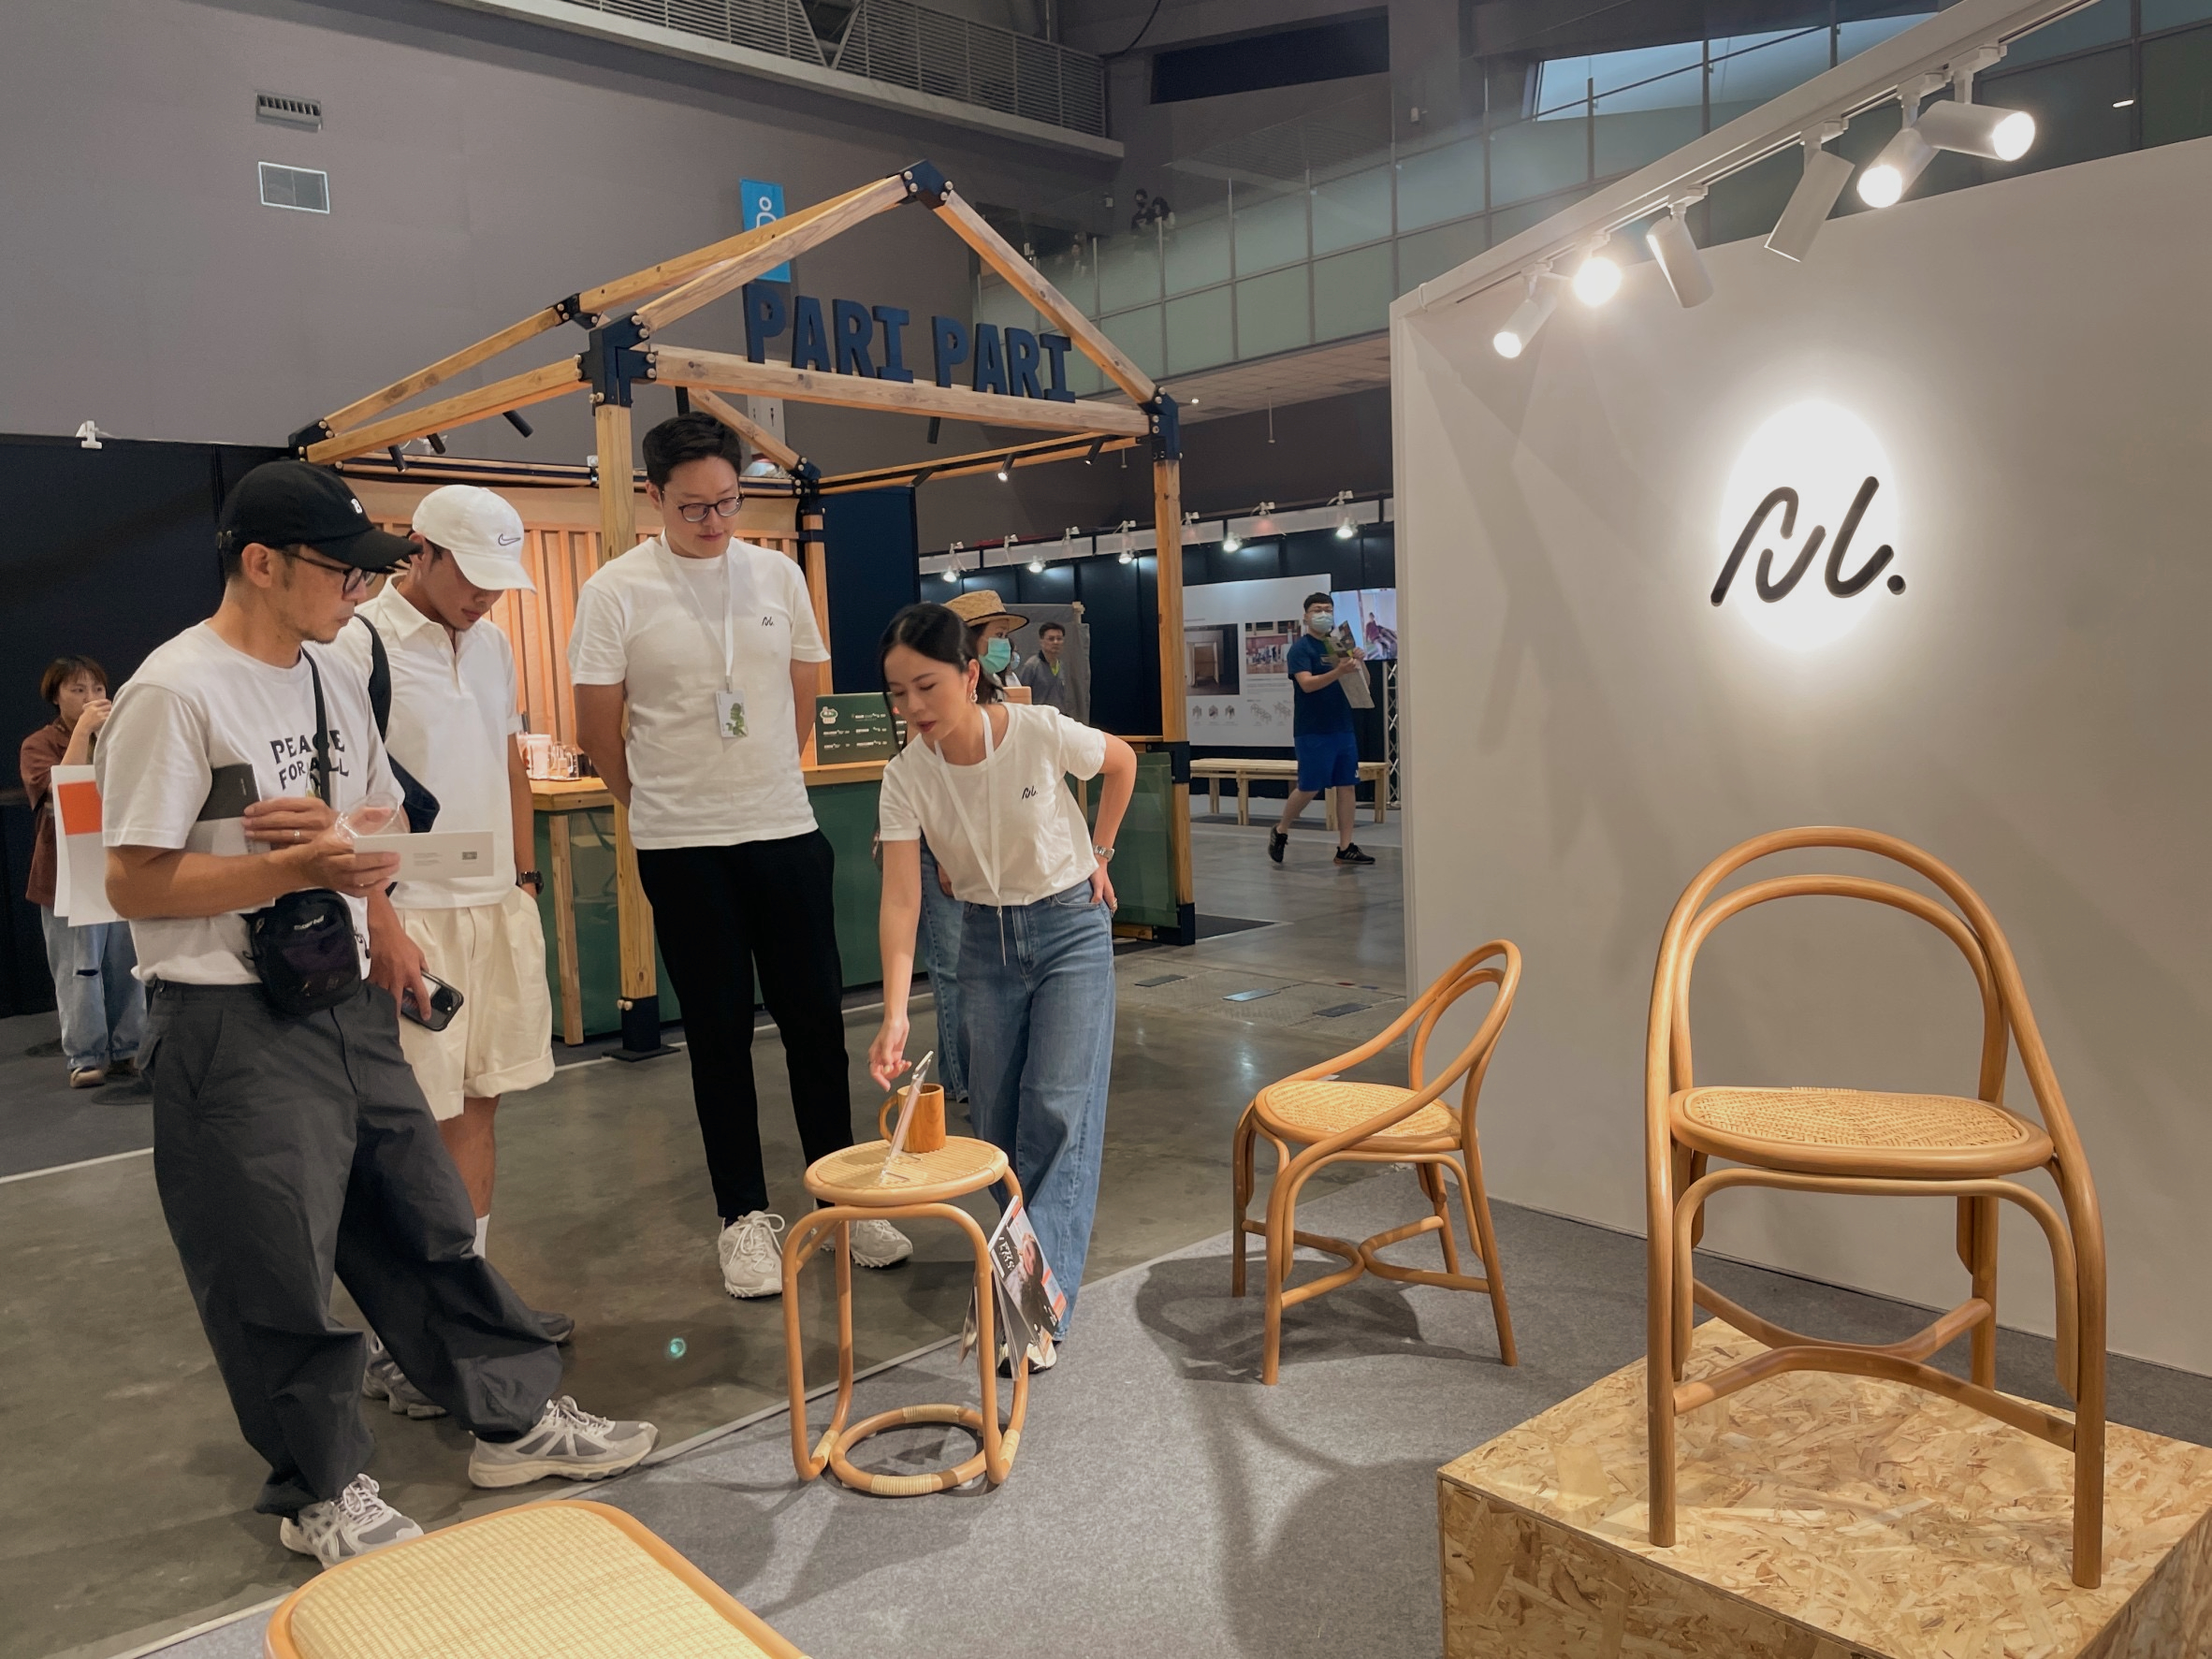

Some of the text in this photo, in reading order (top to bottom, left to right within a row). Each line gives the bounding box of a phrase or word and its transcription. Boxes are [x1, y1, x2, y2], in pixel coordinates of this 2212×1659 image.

[742, 283, 1075, 403] PARI PARI
[279, 760, 306, 791] FOR
